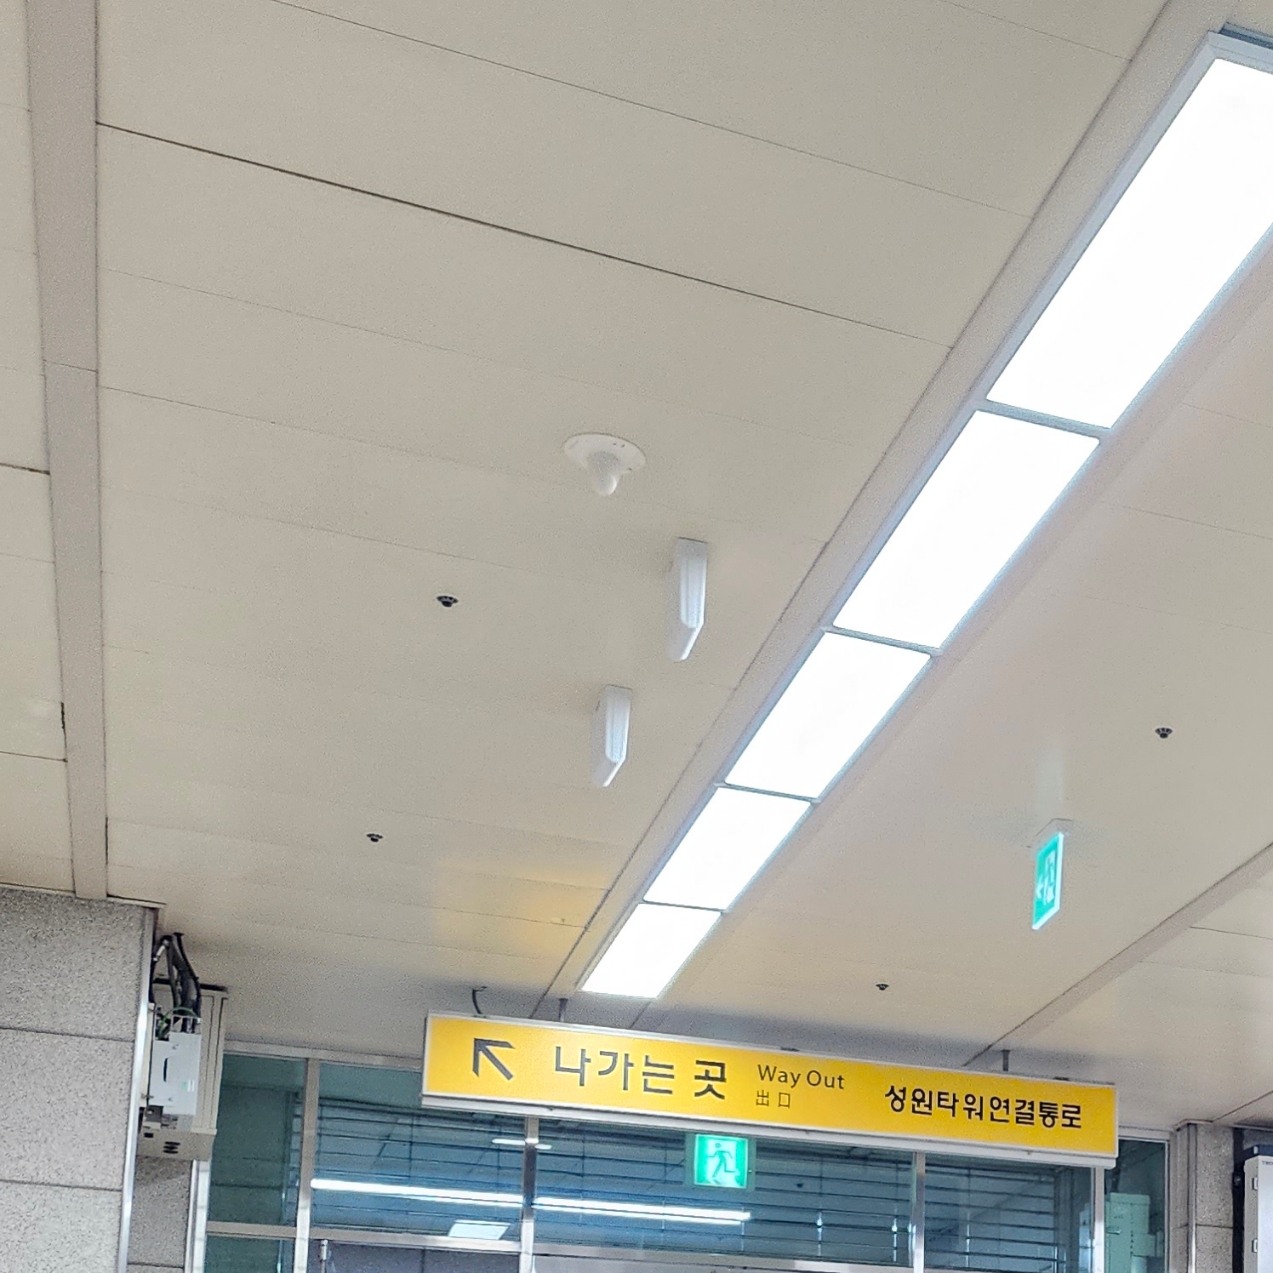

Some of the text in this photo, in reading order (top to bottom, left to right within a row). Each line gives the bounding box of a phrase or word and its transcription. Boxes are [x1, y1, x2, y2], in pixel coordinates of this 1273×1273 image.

[555, 1046, 727, 1100] 나가는 곳
[758, 1064, 845, 1090] Way Out
[755, 1089, 791, 1109] 出口
[884, 1085, 1082, 1129] 성원타워연결통로
